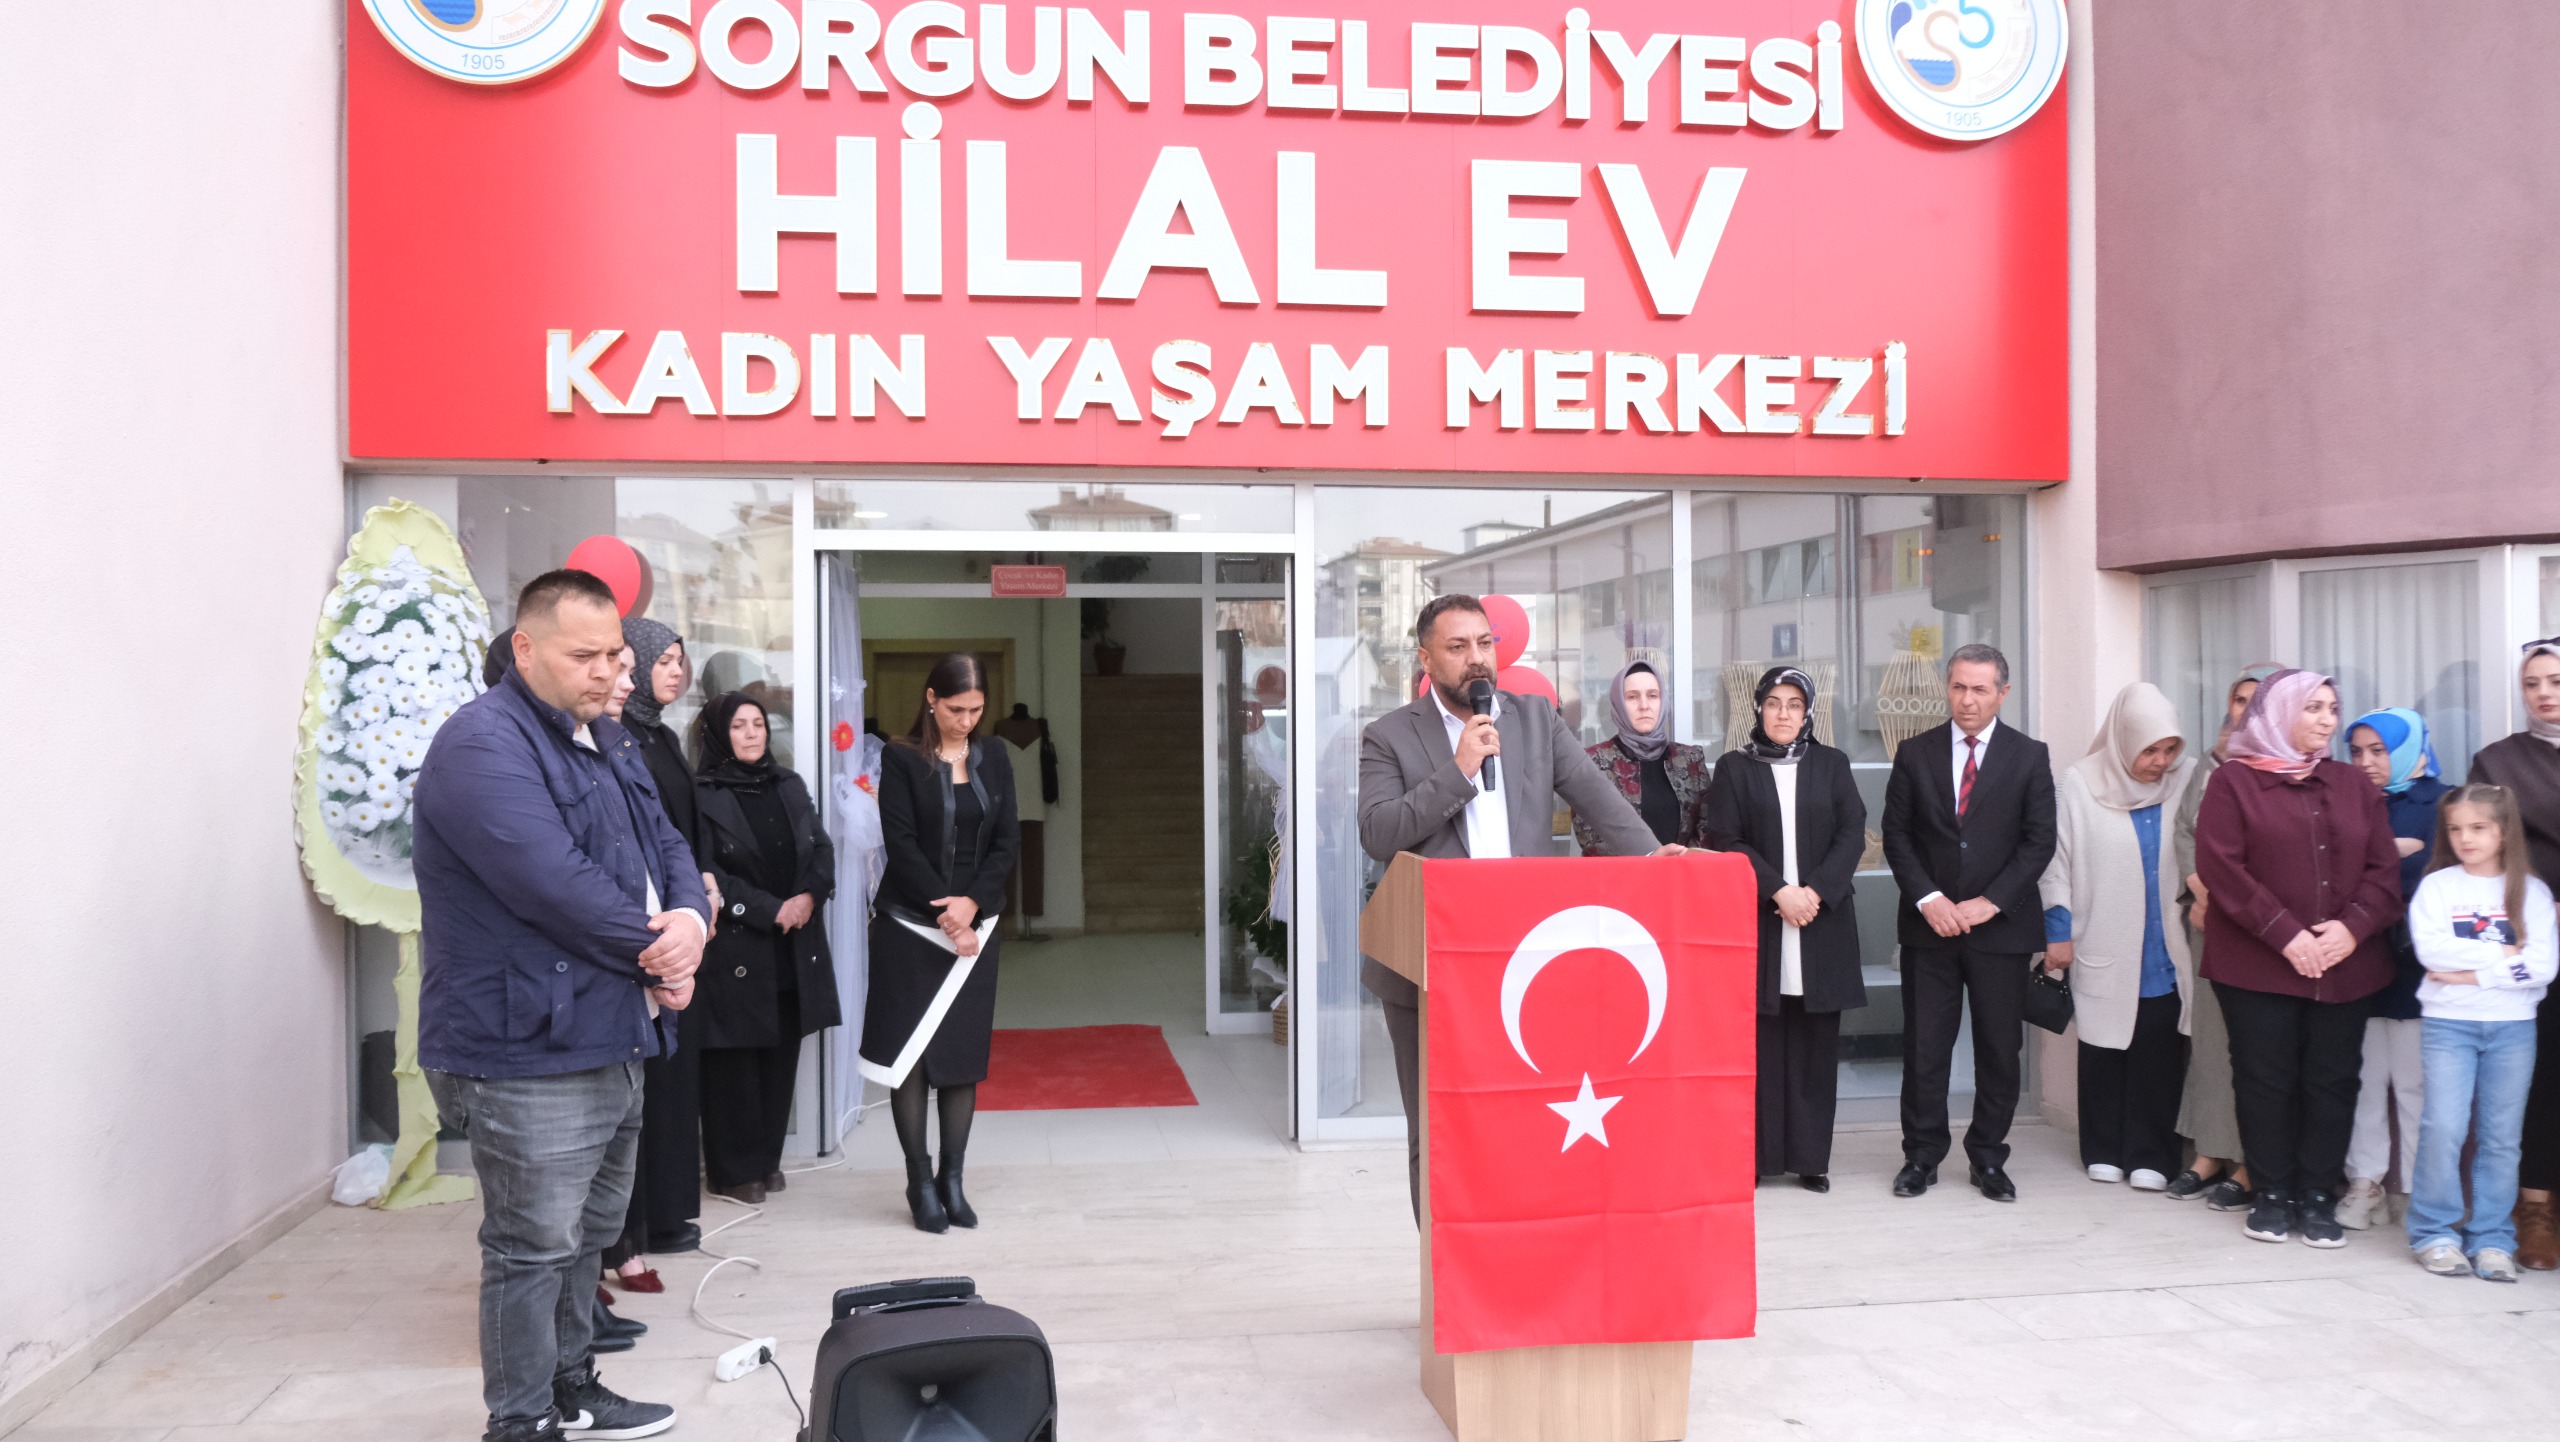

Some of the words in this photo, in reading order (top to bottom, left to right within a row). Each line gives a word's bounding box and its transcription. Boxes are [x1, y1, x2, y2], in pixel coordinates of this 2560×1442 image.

[461, 53, 505, 70] 1905
[617, 0, 1151, 103] SORGUN
[1184, 6, 1845, 131] BELEDİYESİ
[1945, 111, 1982, 126] 1905
[736, 101, 1388, 307] HİLAL
[1471, 158, 1750, 316] EV
[545, 329, 926, 418] KADIN
[985, 336, 1391, 438] YAŞAM
[1446, 340, 1908, 436] MERKEZİ
